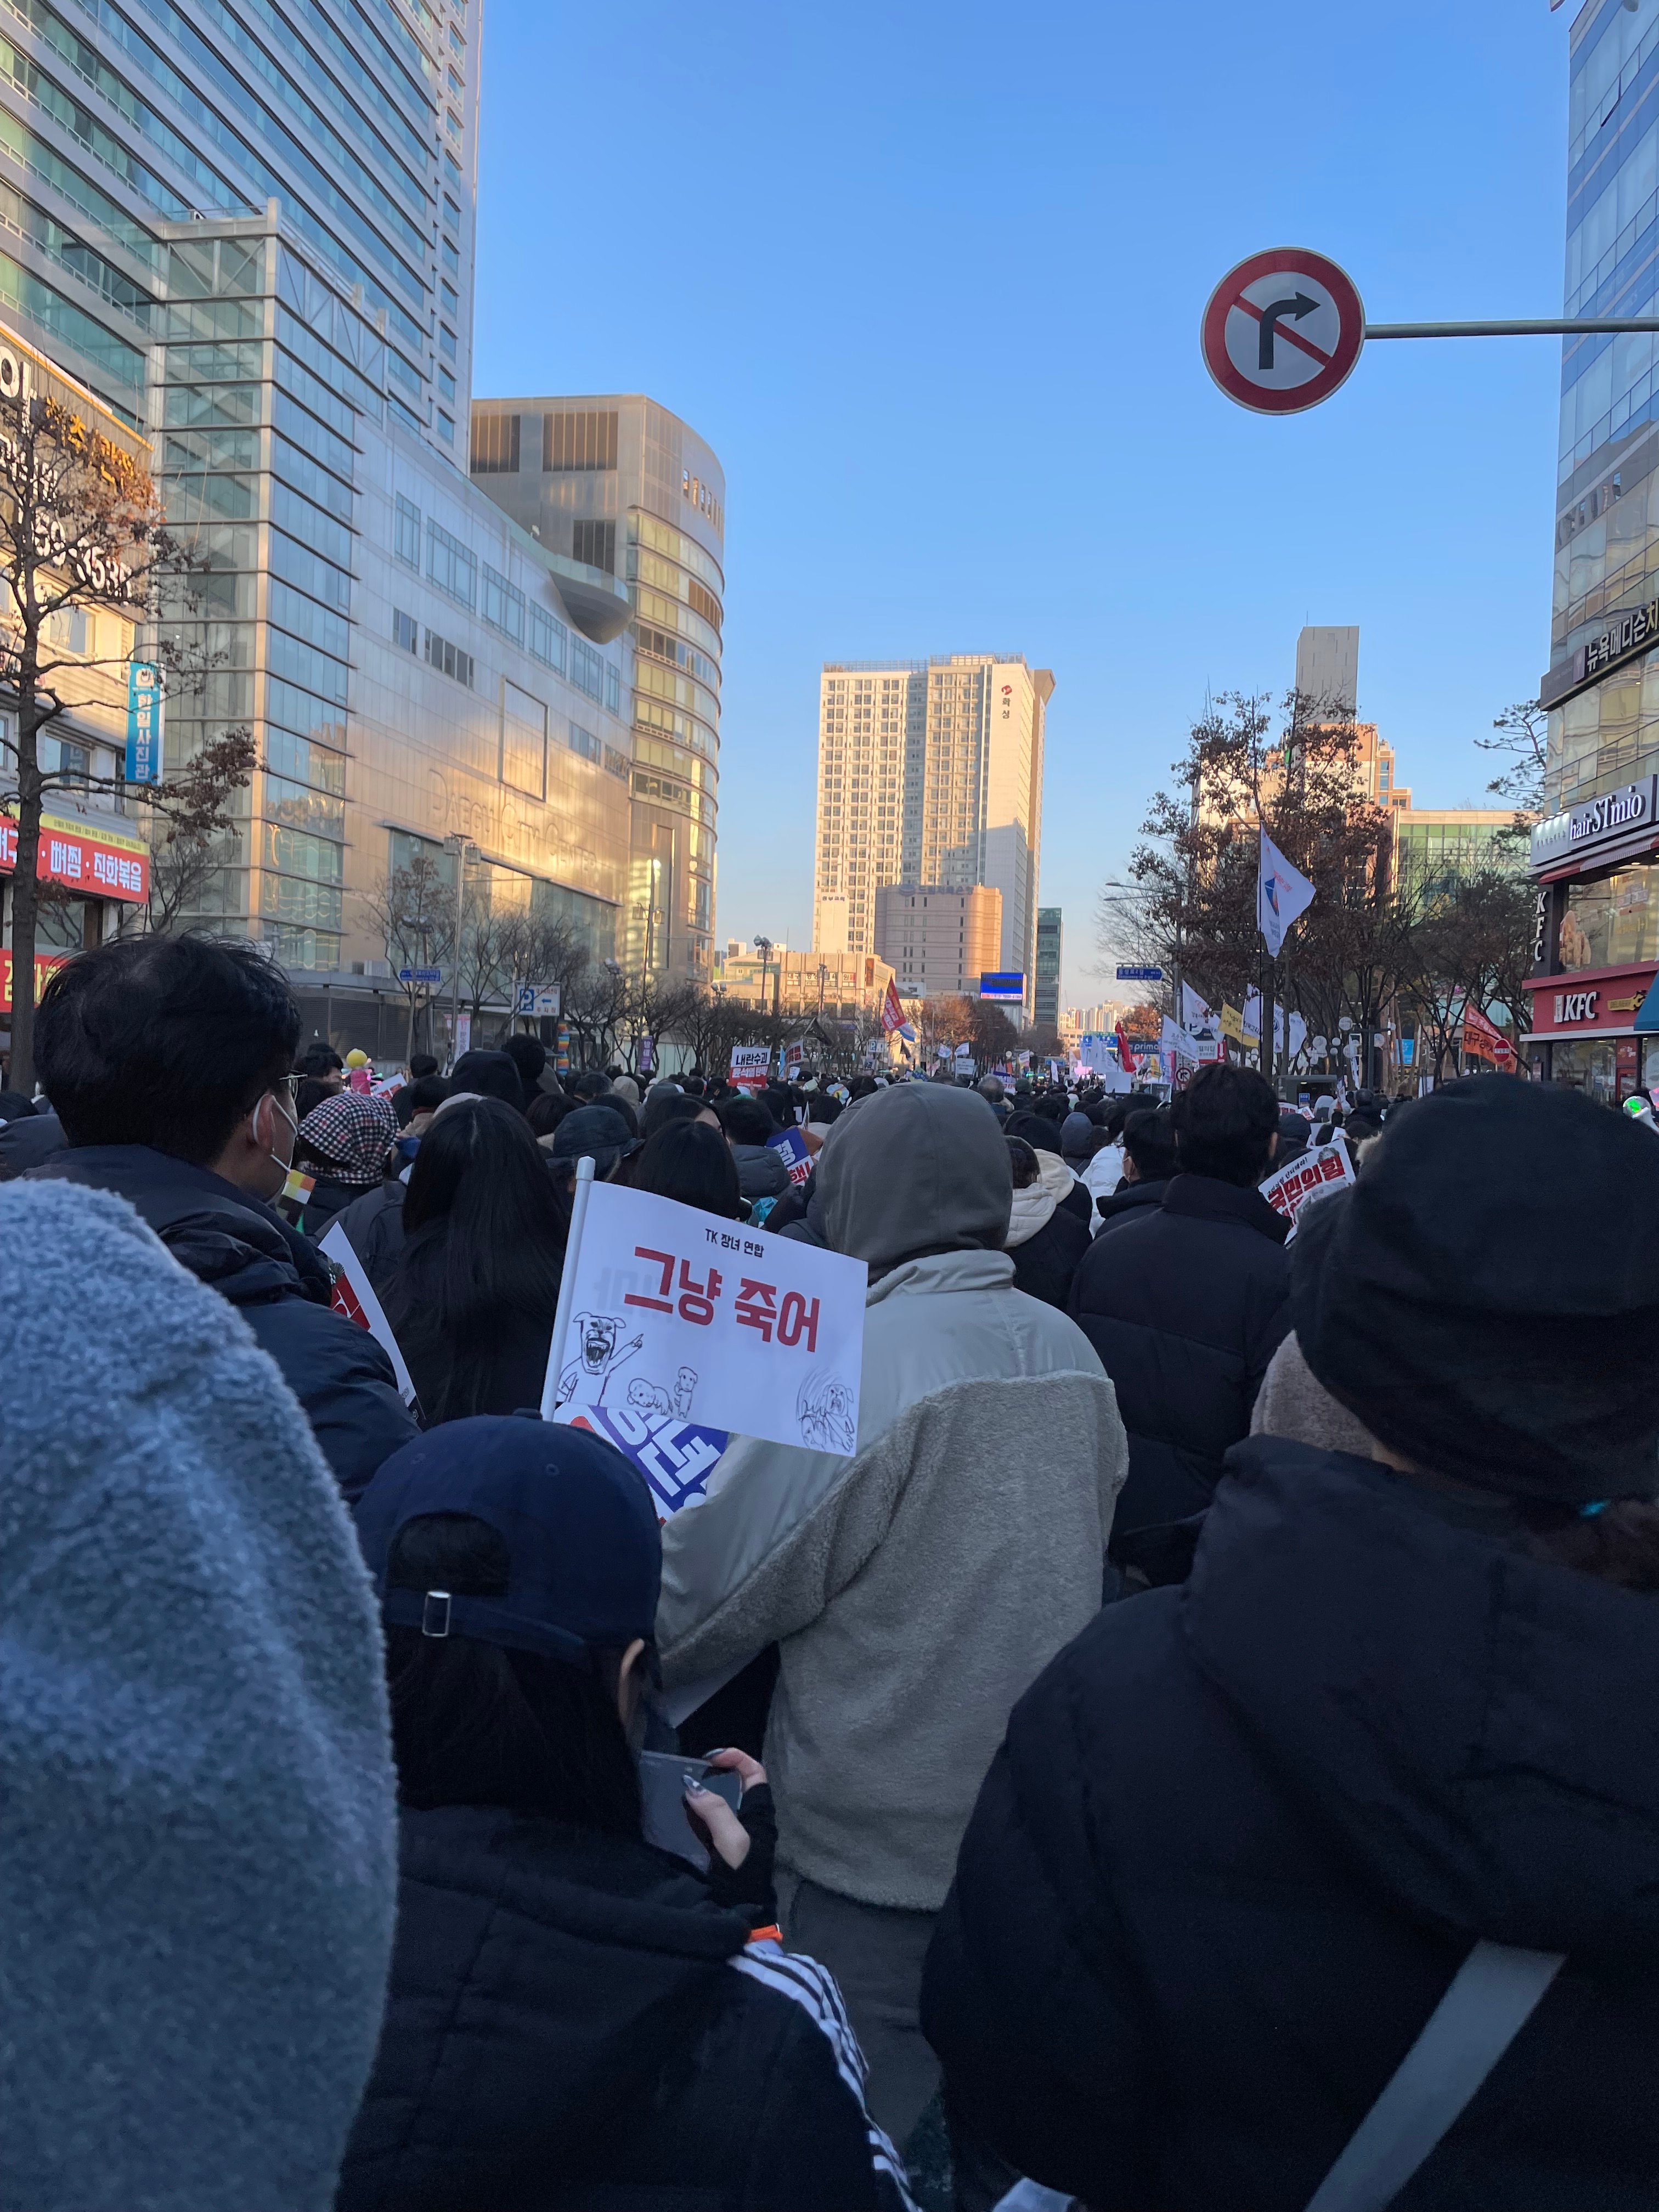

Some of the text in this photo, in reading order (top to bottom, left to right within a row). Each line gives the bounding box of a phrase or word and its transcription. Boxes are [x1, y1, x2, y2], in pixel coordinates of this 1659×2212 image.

[1534, 891, 1547, 961] KFC
[1563, 991, 1597, 1022] KFC
[736, 1052, 768, 1065] 내란수괴
[1267, 1154, 1346, 1210] 국민의힘
[705, 1228, 764, 1258] TK 장녀 연합
[624, 1246, 722, 1326] 그냥
[735, 1277, 821, 1353] 죽어
